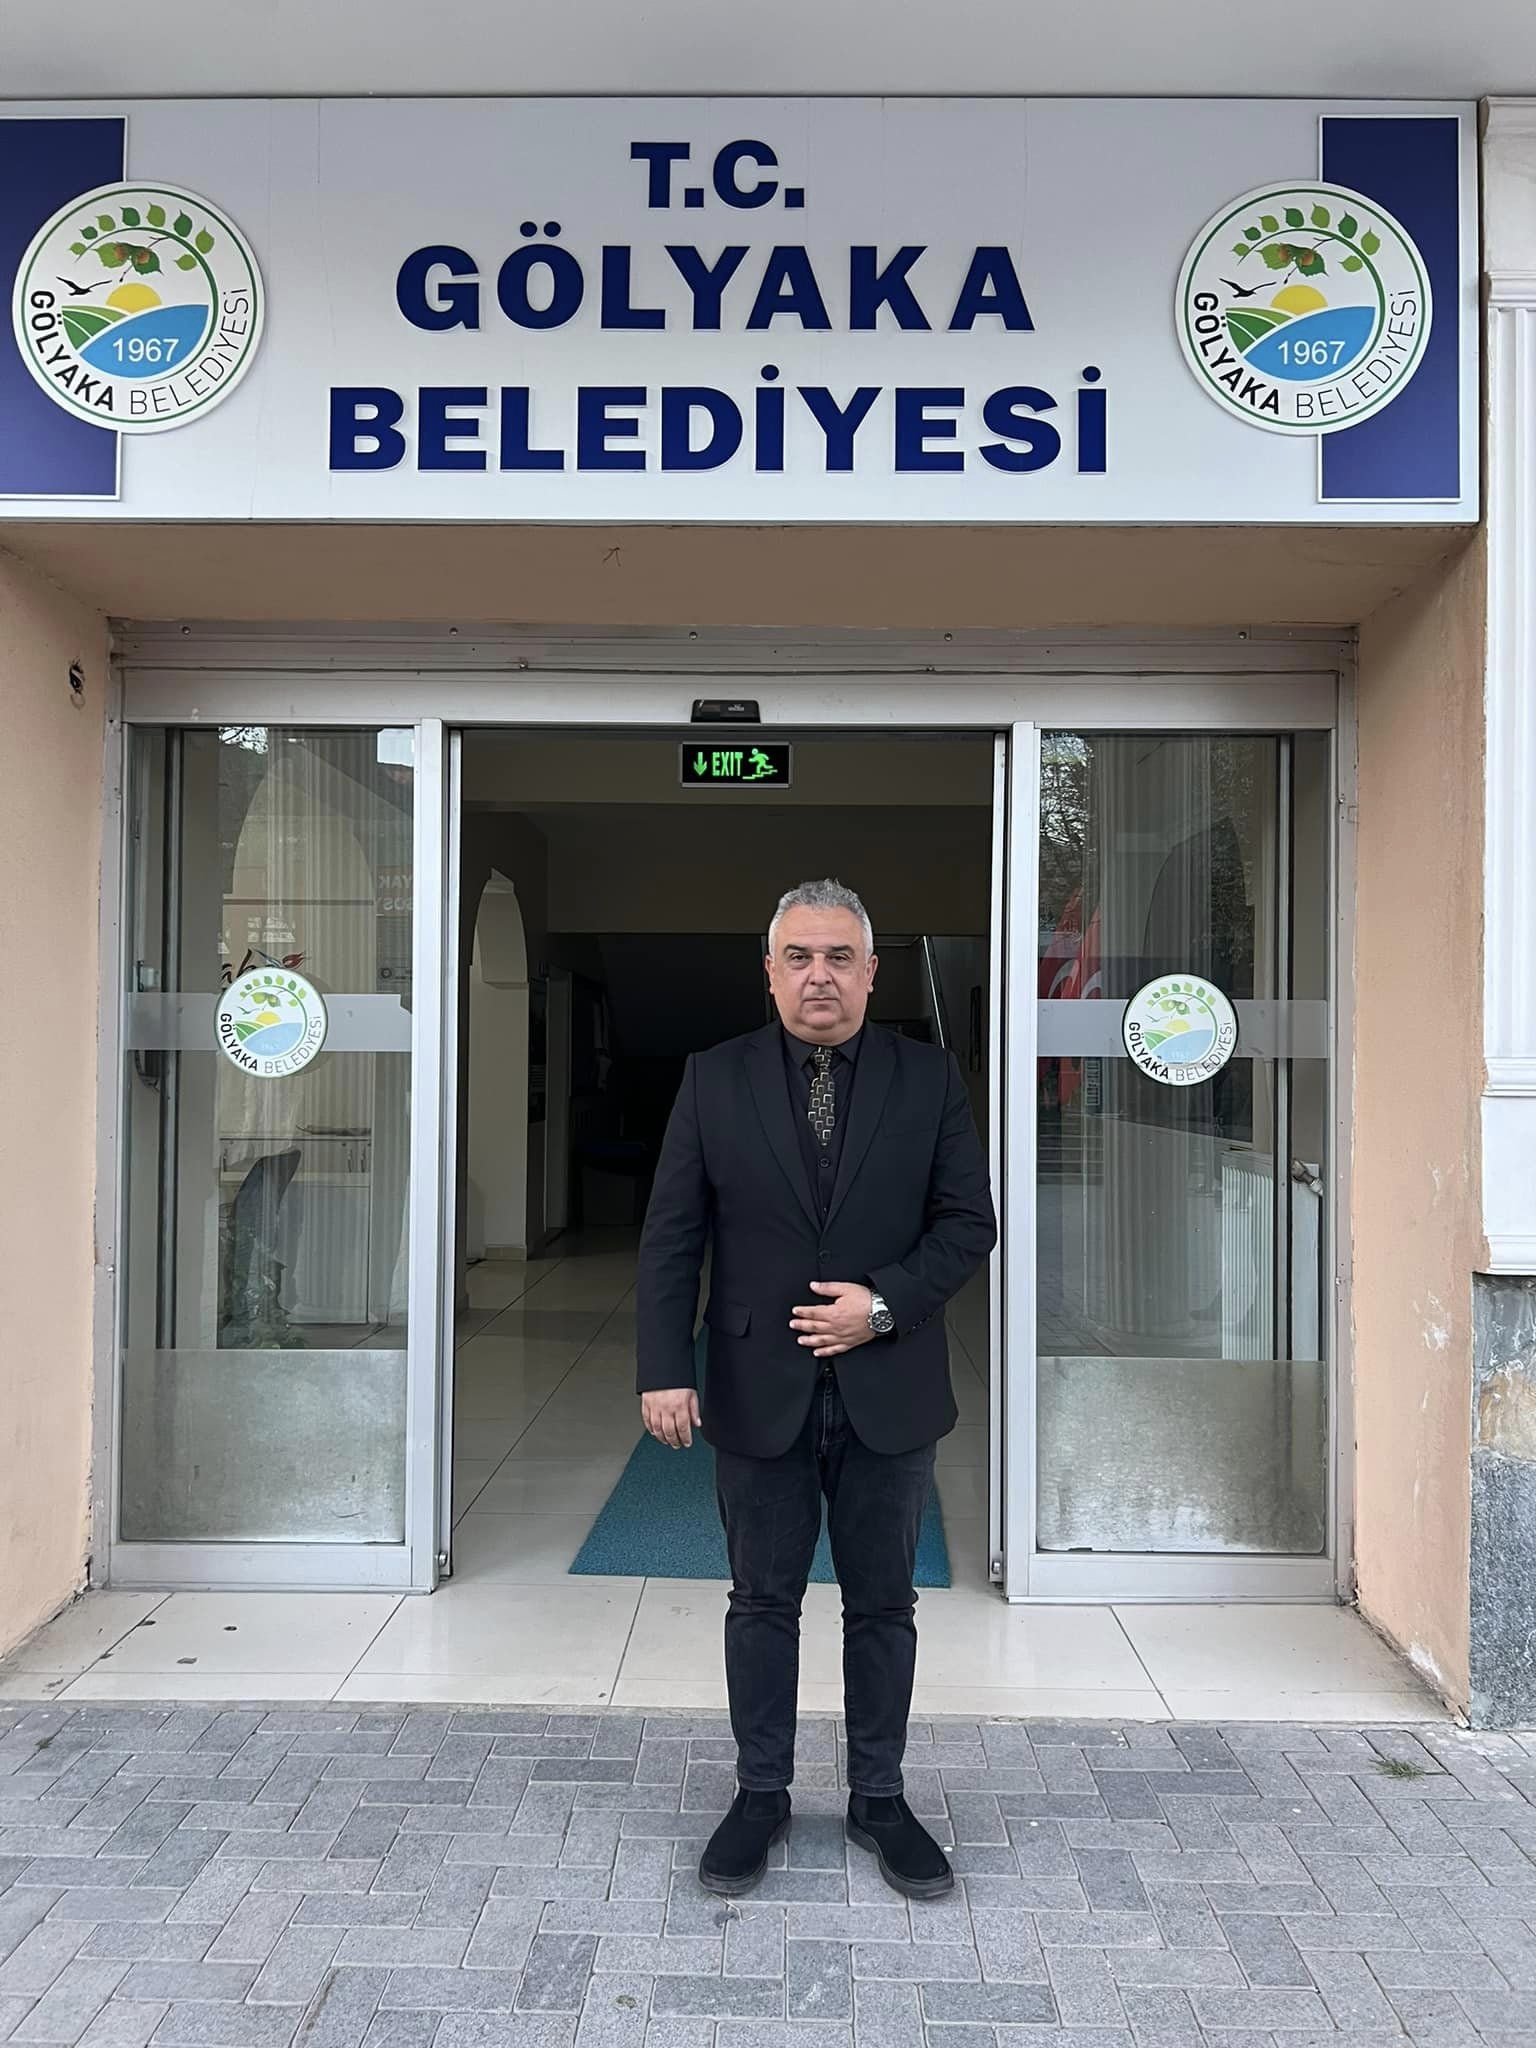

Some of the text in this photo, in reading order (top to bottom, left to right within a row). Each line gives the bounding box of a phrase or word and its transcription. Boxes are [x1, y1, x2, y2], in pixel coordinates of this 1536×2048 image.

[630, 140, 804, 208] T.C.
[396, 221, 1035, 331] GÖLYAKA
[30, 290, 114, 412] GÖLYAKA
[112, 338, 179, 363] 1967
[1193, 292, 1280, 415] GÖLYAKA
[1278, 340, 1346, 365] 1967
[329, 365, 1107, 474] BELEDİYESİ
[712, 752, 743, 776] EXIT
[220, 1013, 258, 1071] GÖLYAKA
[1129, 1022, 1169, 1079] GÖLYAKA
